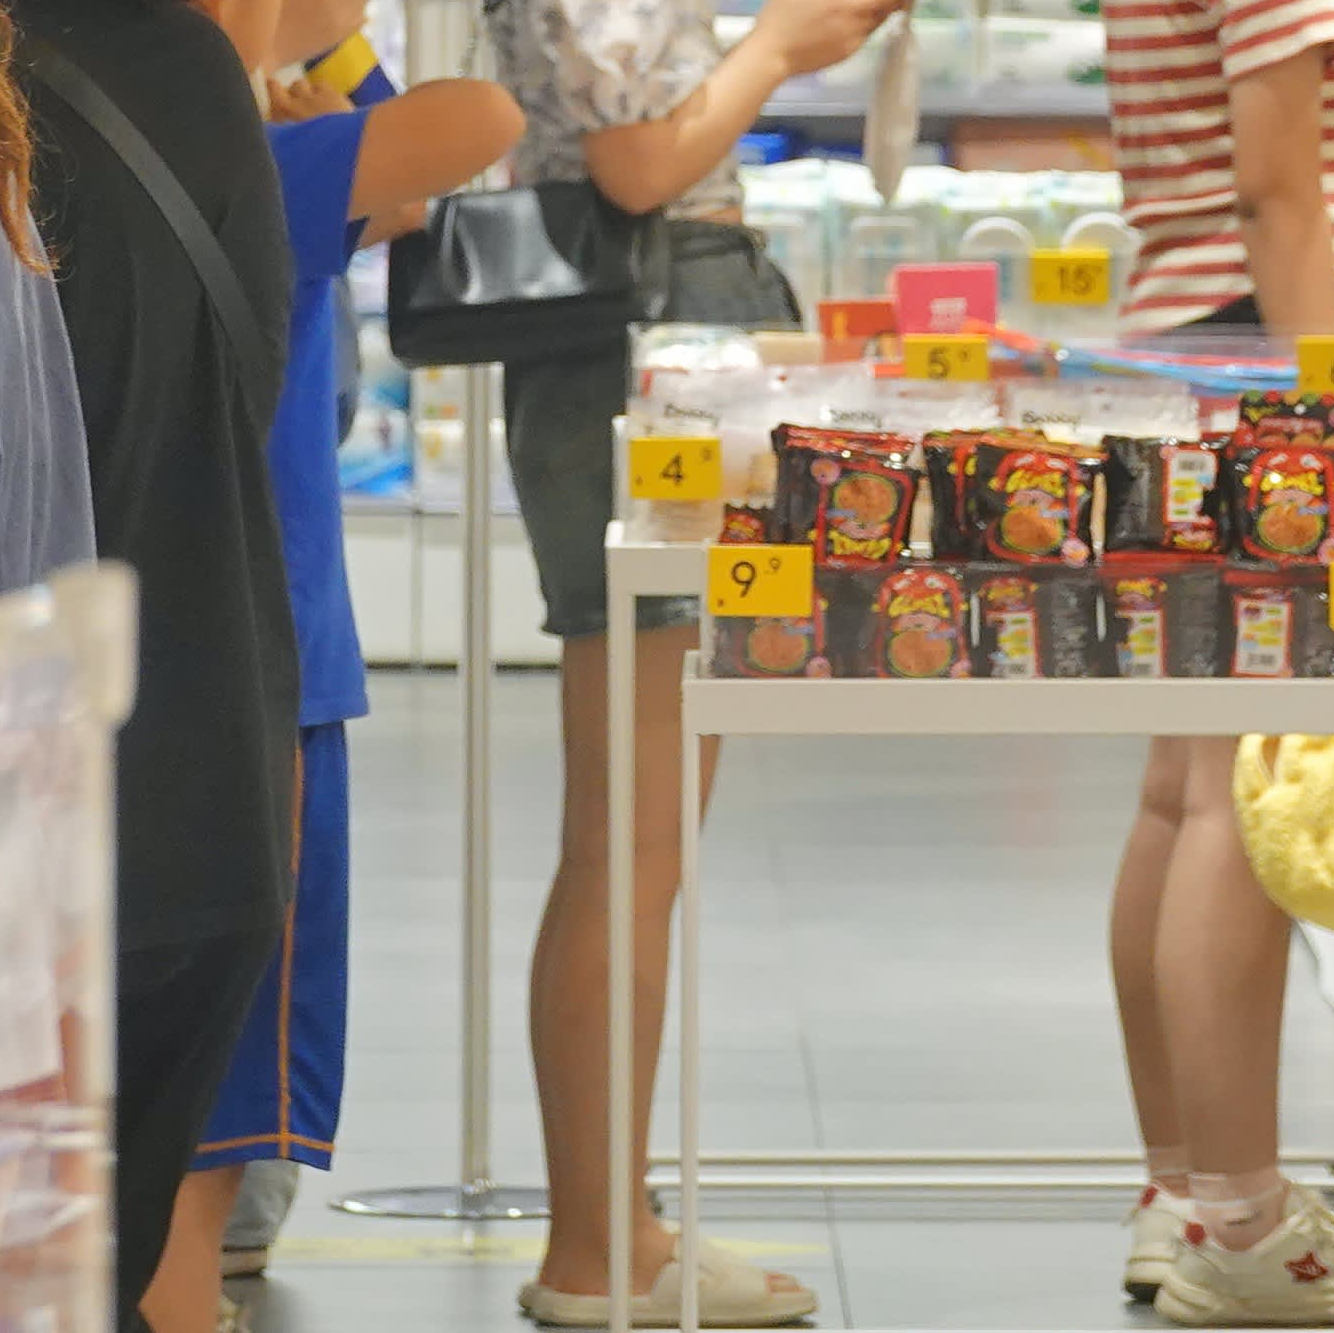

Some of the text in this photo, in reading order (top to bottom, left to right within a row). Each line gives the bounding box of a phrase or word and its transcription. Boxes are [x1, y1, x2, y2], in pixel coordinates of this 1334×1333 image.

[927, 347, 950, 380] 5
[660, 451, 684, 486] 4
[729, 560, 757, 598] 9
